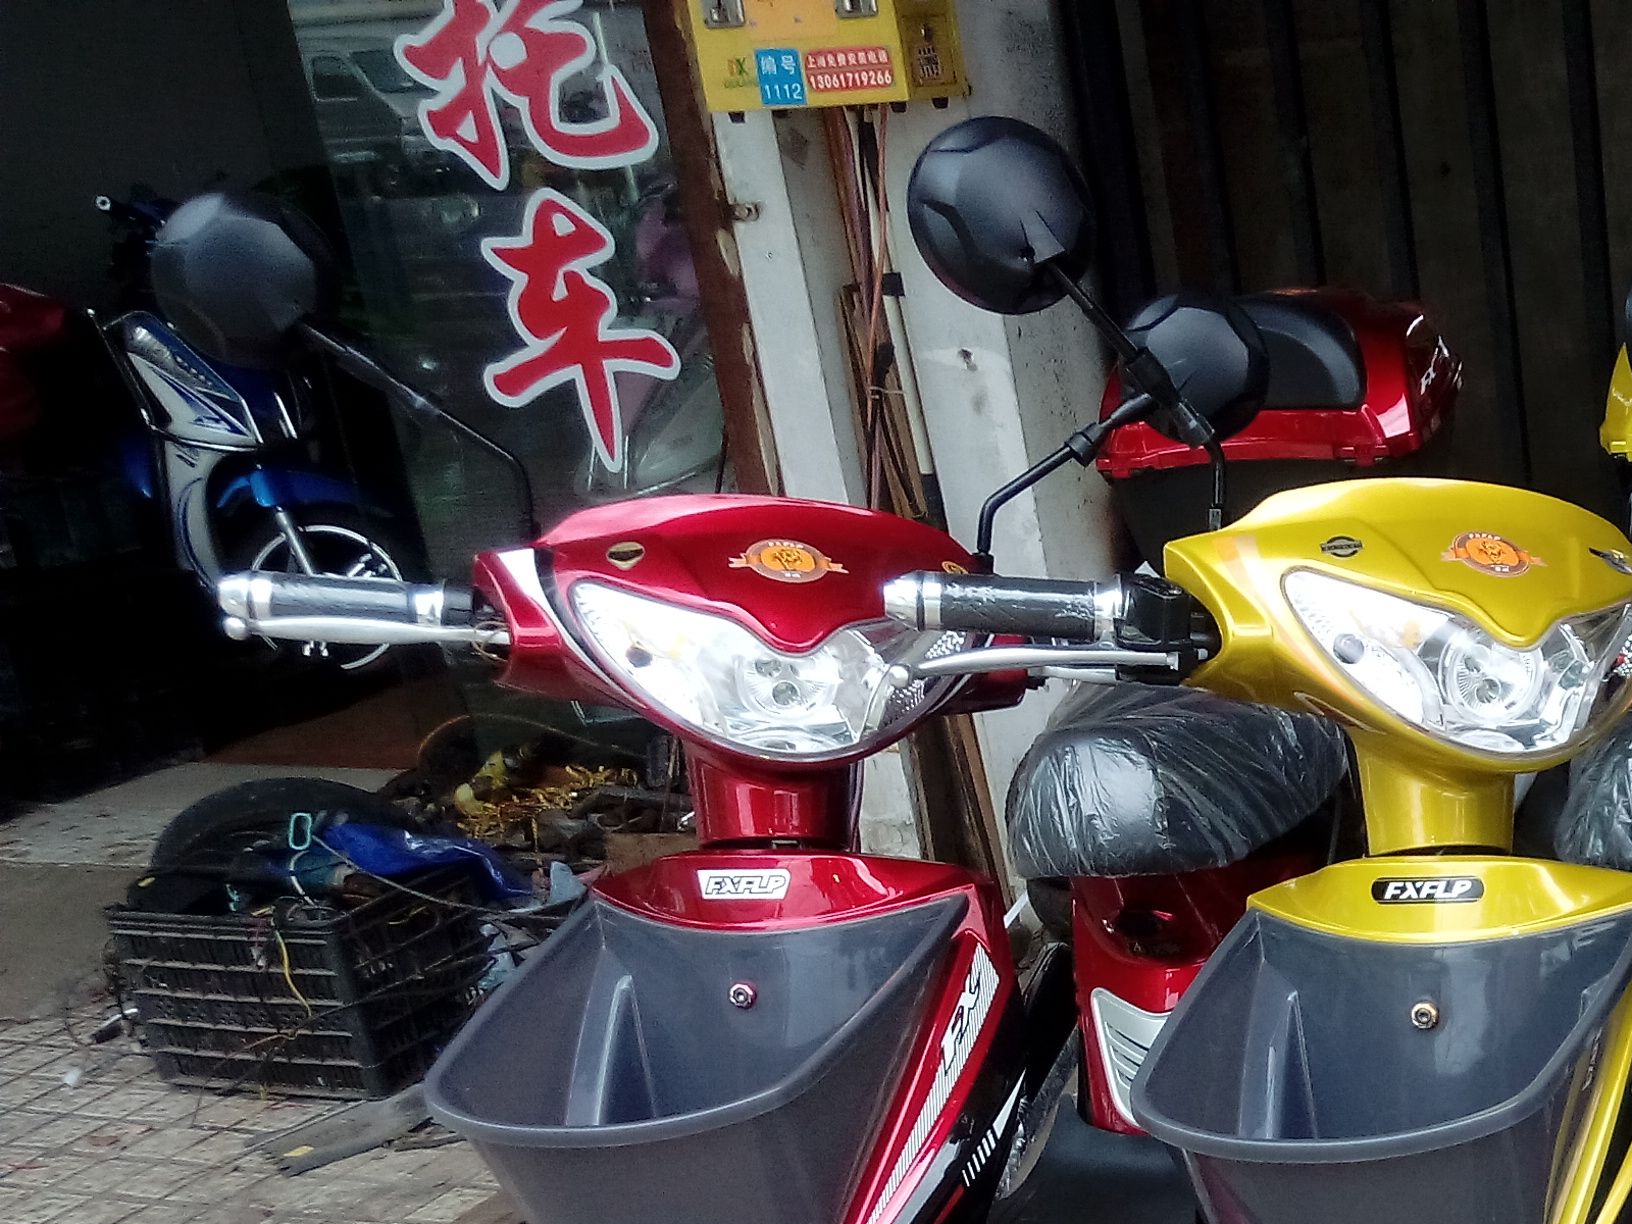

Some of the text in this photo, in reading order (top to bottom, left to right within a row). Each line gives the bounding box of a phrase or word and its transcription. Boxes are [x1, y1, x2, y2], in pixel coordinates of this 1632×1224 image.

[761, 54, 797, 75] 编号
[810, 70, 892, 90] 13061719266
[764, 83, 802, 100] 1112
[705, 872, 788, 897] FXFLP
[1382, 879, 1473, 900] FXFLP
